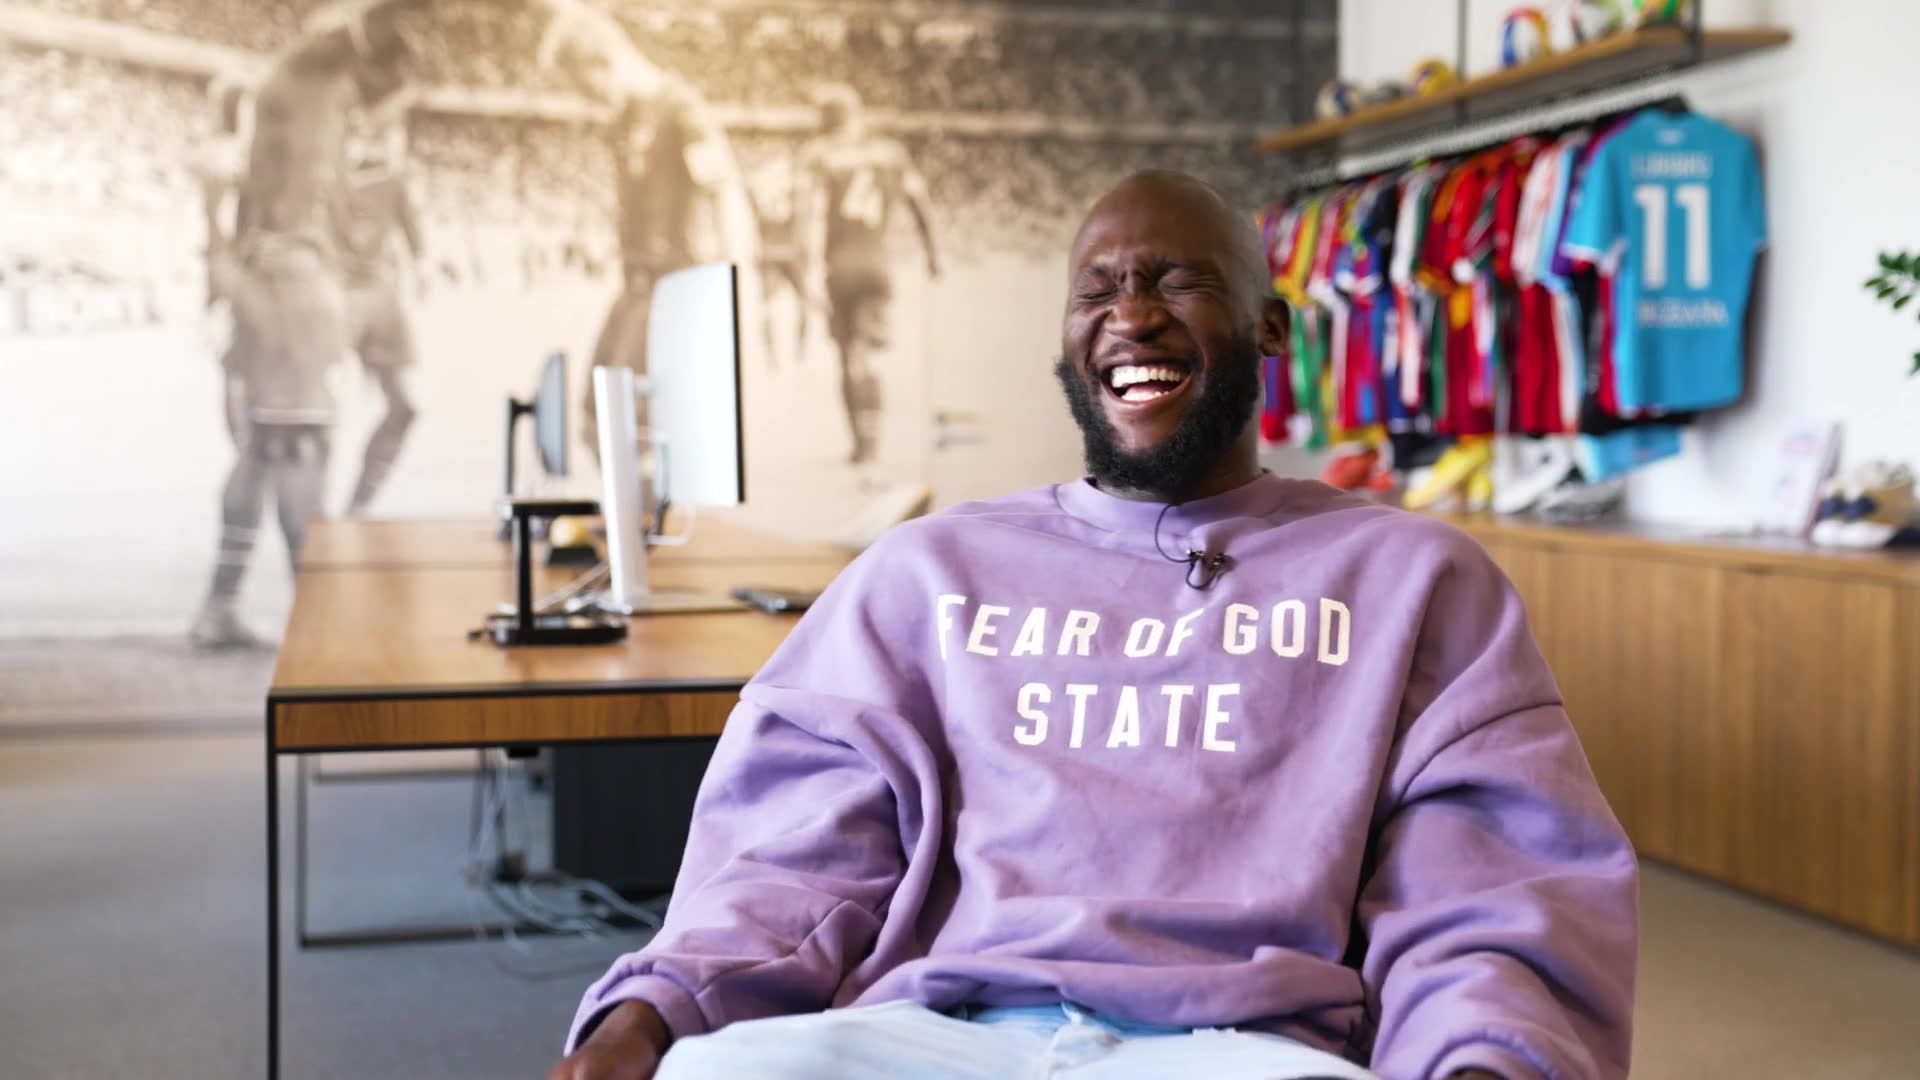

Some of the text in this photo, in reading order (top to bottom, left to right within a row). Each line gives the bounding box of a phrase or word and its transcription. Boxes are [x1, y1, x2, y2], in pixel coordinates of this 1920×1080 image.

[1635, 183, 1710, 290] 11
[938, 594, 1351, 666] FEAR OF GOD
[1013, 682, 1240, 752] STATE
